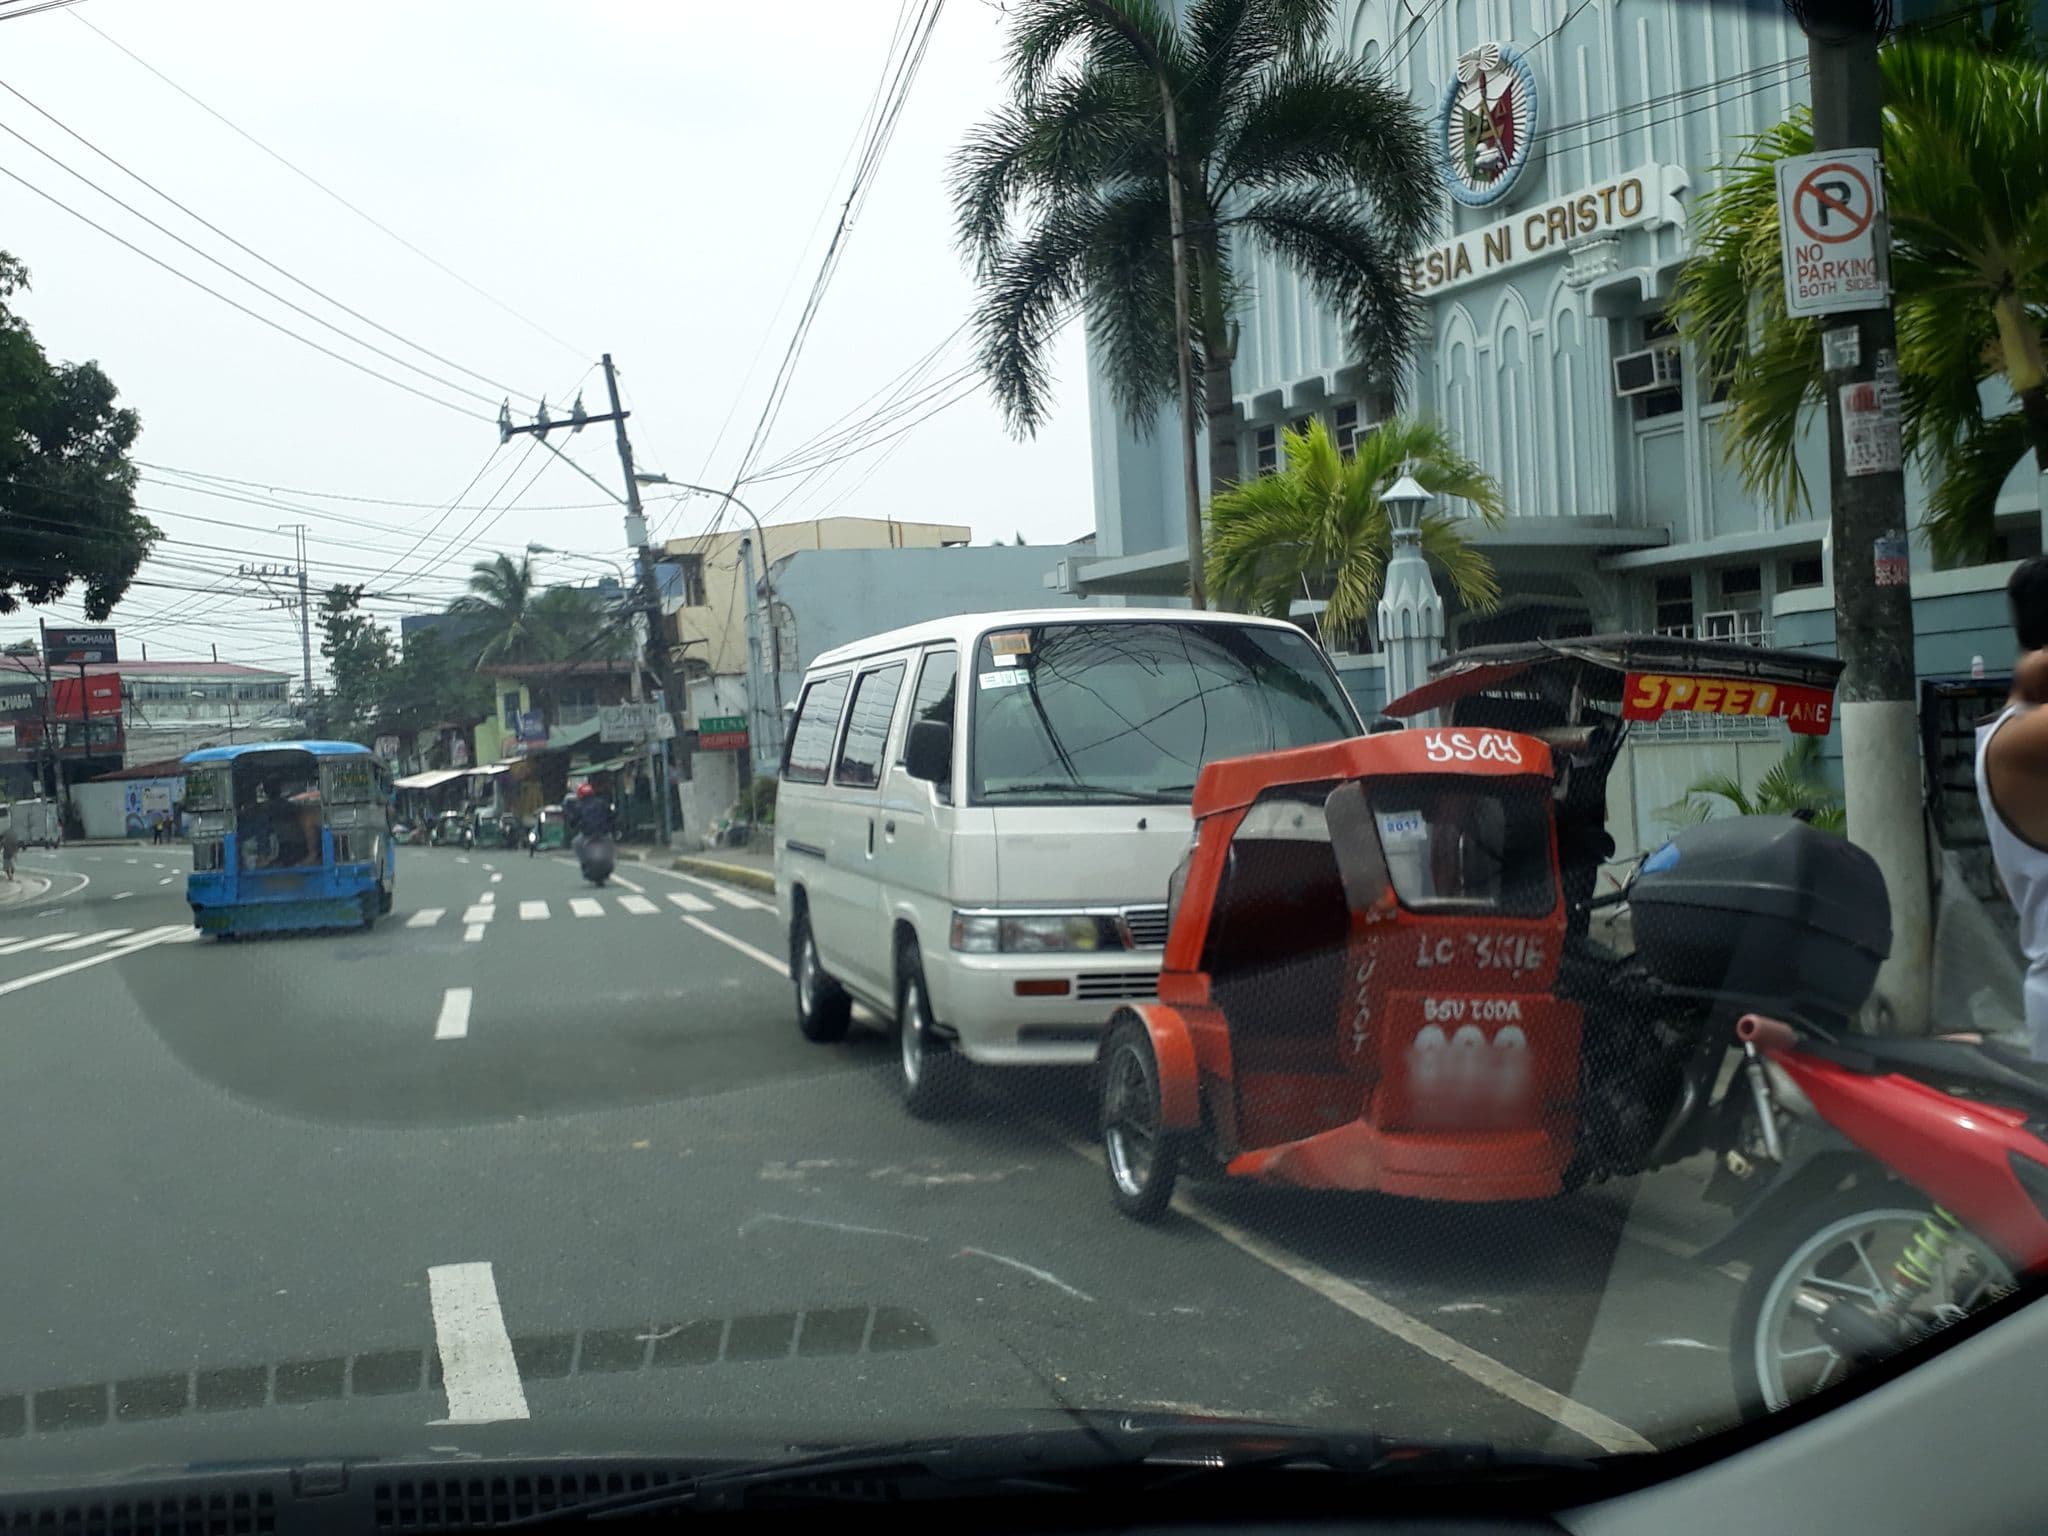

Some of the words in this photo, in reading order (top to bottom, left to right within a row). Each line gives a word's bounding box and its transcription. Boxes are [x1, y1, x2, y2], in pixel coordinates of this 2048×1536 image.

[1816, 181, 1852, 226] P
[1483, 225, 1512, 267] NI
[1523, 178, 1643, 252] CRISTO
[1795, 243, 1824, 263] NO
[1799, 281, 1837, 298] BOTH
[65, 634, 114, 645] YOKOHAMA
[1632, 675, 1778, 717] SPEED
[1778, 701, 1828, 723] LANE
